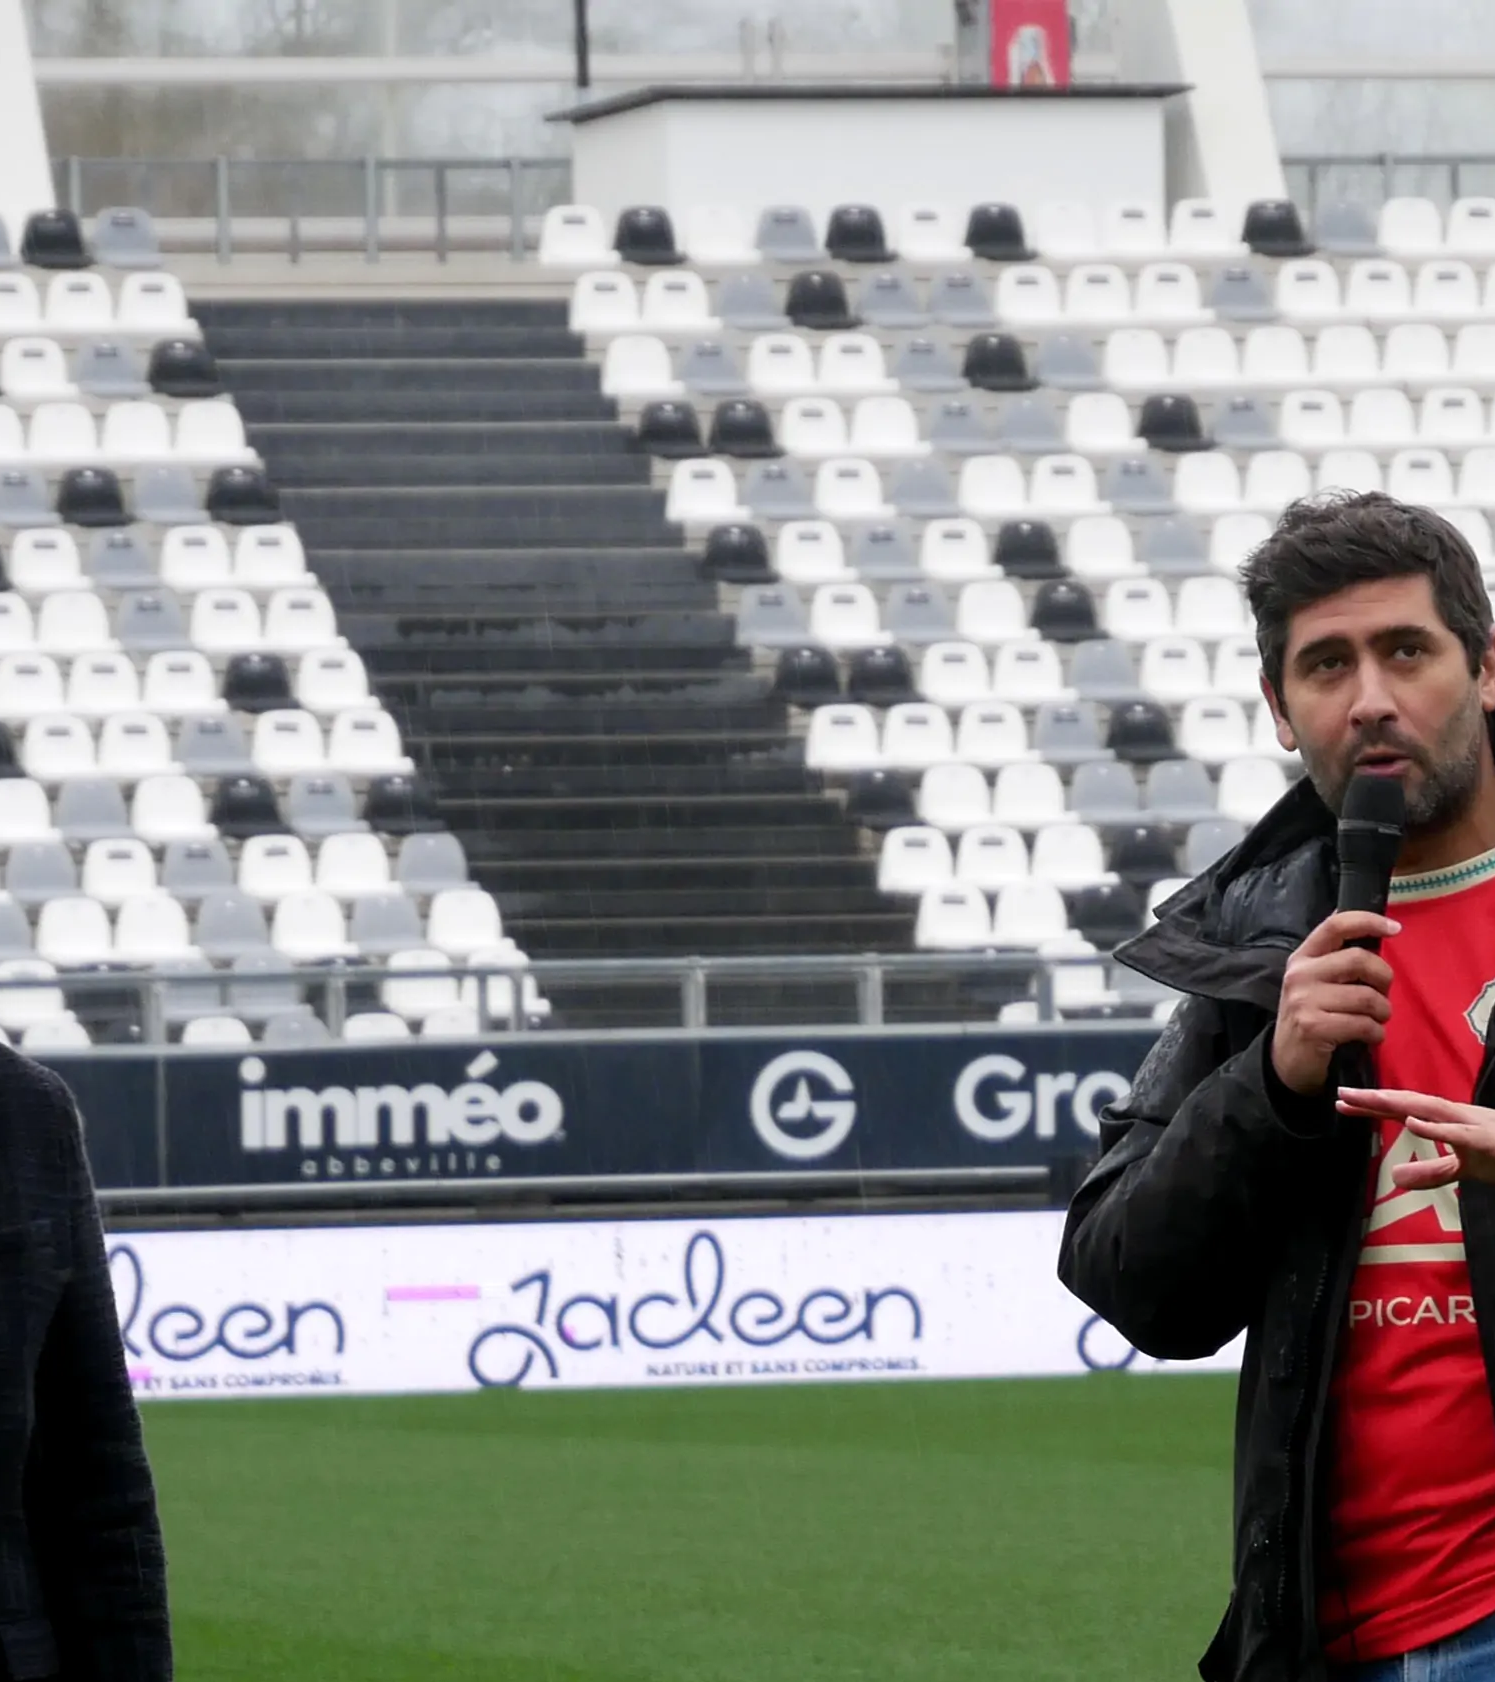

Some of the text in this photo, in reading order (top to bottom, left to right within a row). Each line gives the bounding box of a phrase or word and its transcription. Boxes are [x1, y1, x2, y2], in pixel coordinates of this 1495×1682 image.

[239, 1049, 563, 1150] imméo
[302, 1152, 502, 1177] abbeville
[646, 1361, 718, 1377] NATURE
[724, 1361, 744, 1375] ET
[750, 1359, 798, 1375] SANS
